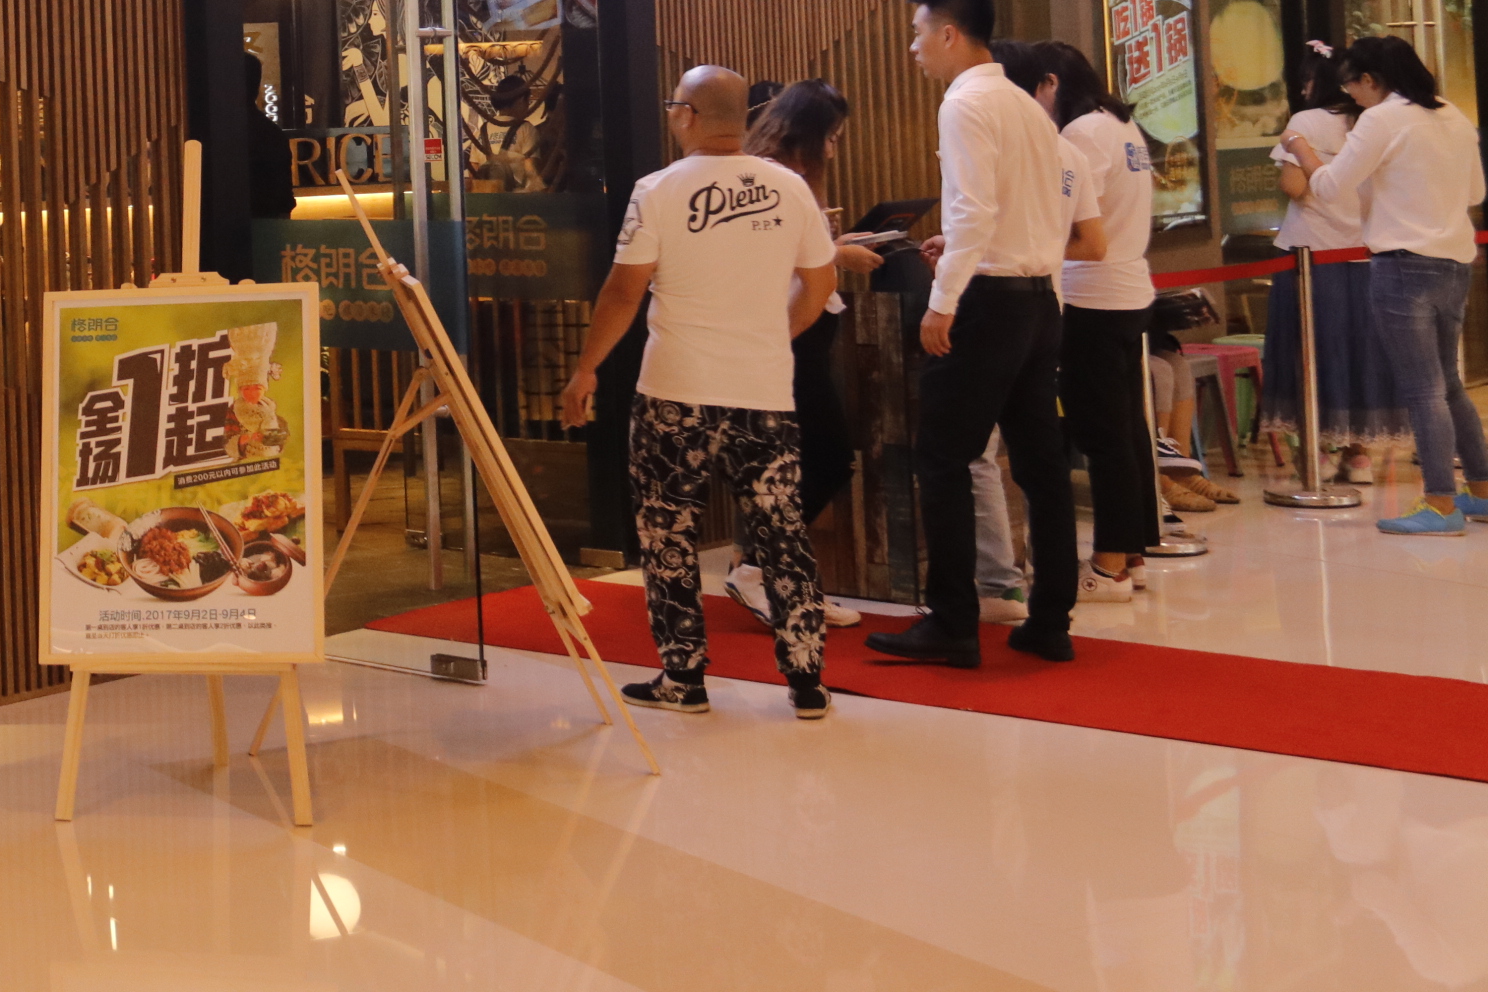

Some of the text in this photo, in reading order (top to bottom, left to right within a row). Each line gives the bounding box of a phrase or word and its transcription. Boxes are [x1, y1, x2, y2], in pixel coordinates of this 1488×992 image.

[1126, 16, 1189, 89] 送1锅
[288, 133, 393, 186] RICE
[688, 181, 780, 233] Plein
[70, 317, 119, 332] 格朗合
[177, 460, 278, 486] 消费200元以内可参加此活动
